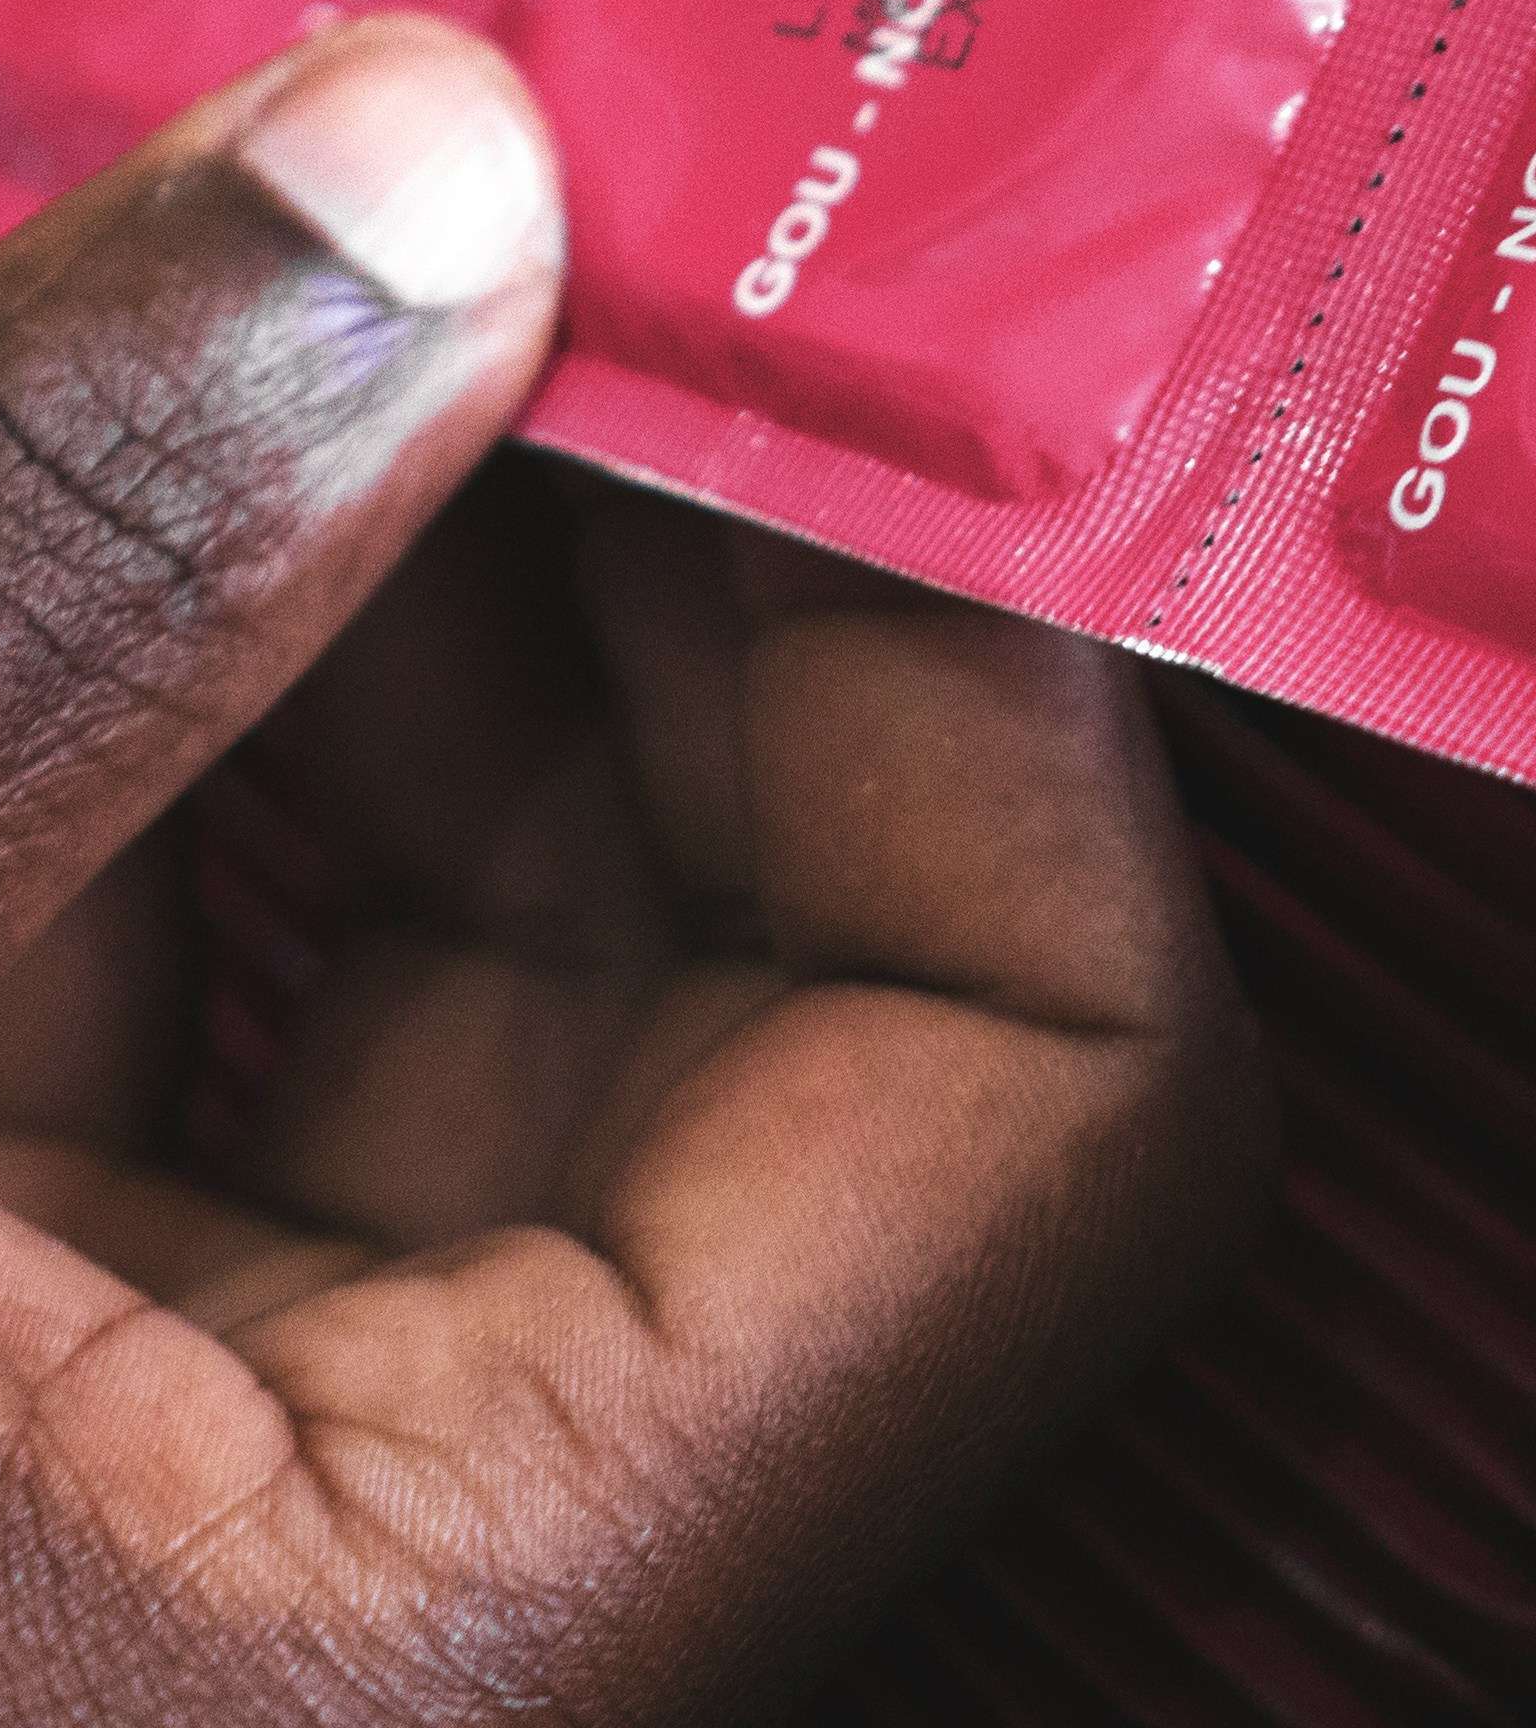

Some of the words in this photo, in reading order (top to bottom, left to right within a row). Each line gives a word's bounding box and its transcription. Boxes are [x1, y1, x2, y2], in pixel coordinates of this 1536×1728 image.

[732, 145, 860, 319] GOU
[1389, 338, 1497, 532] GOU
[1492, 284, 1513, 313] -
